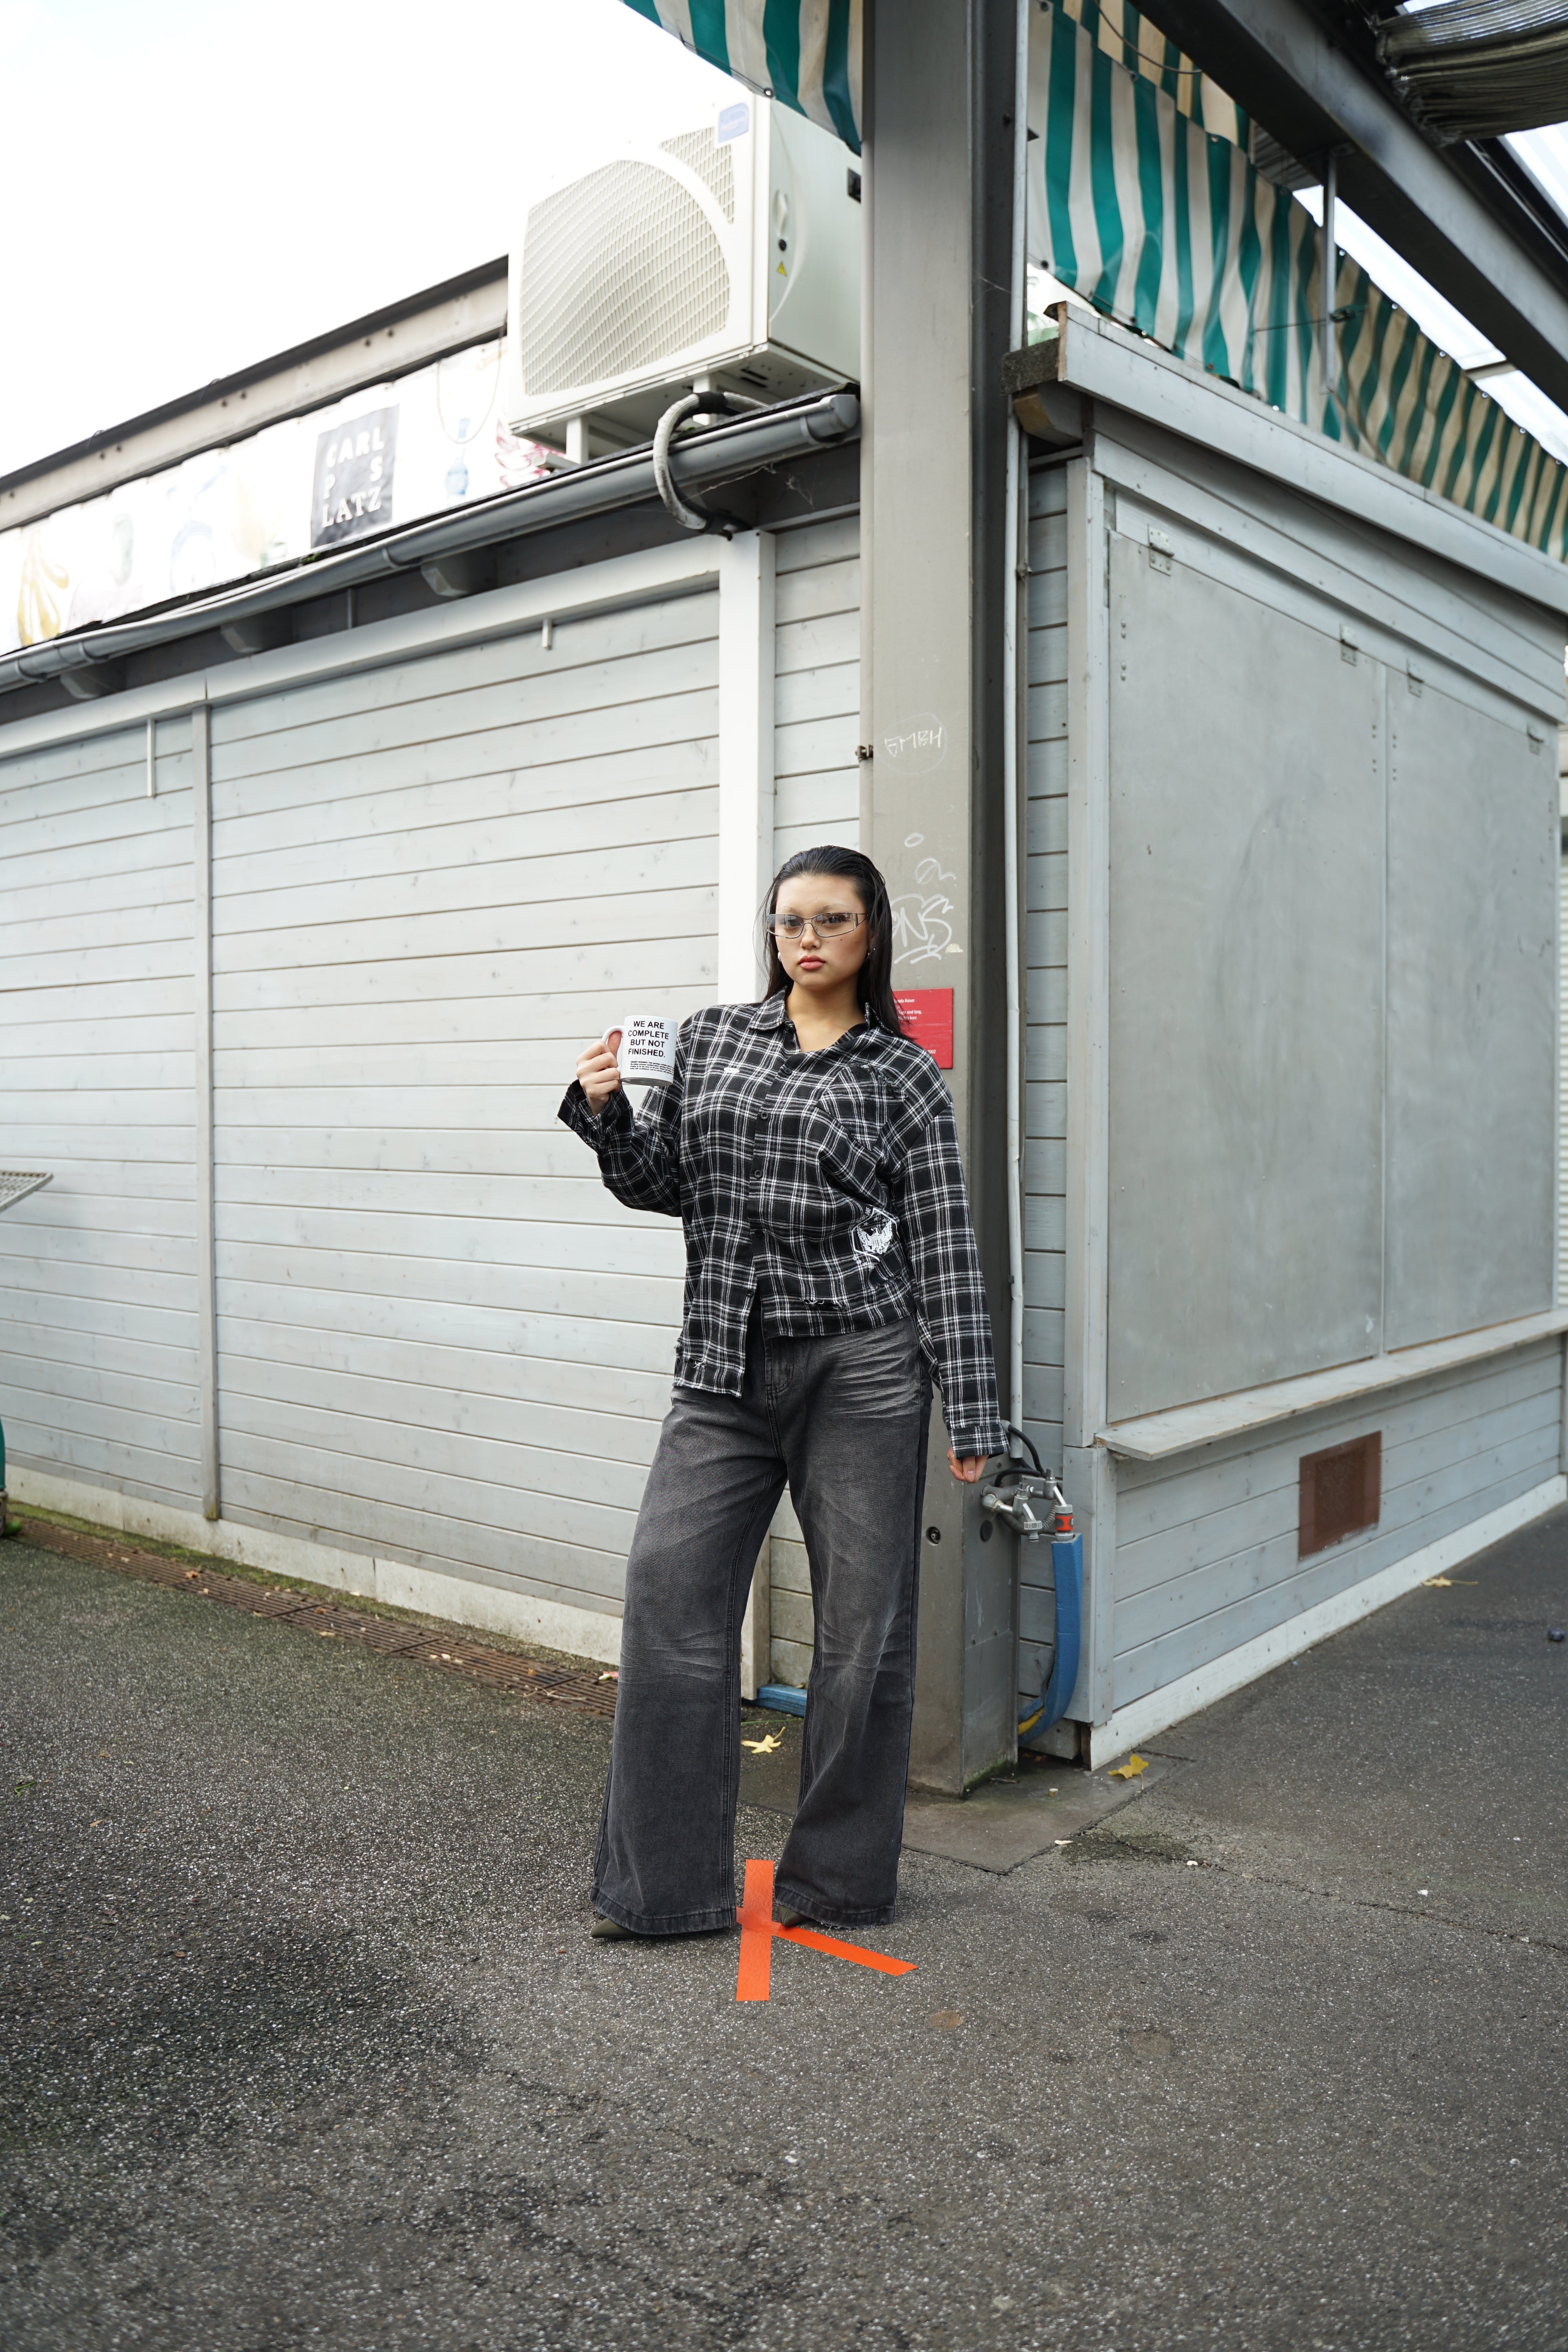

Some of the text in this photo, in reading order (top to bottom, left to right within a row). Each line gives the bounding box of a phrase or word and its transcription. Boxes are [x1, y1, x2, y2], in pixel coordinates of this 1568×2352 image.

[327, 427, 384, 468] CARL
[323, 456, 383, 499] P S
[321, 486, 382, 528] LATZ
[628, 1030, 669, 1040] COMPLETE
[628, 1048, 665, 1058] FINISHED.
